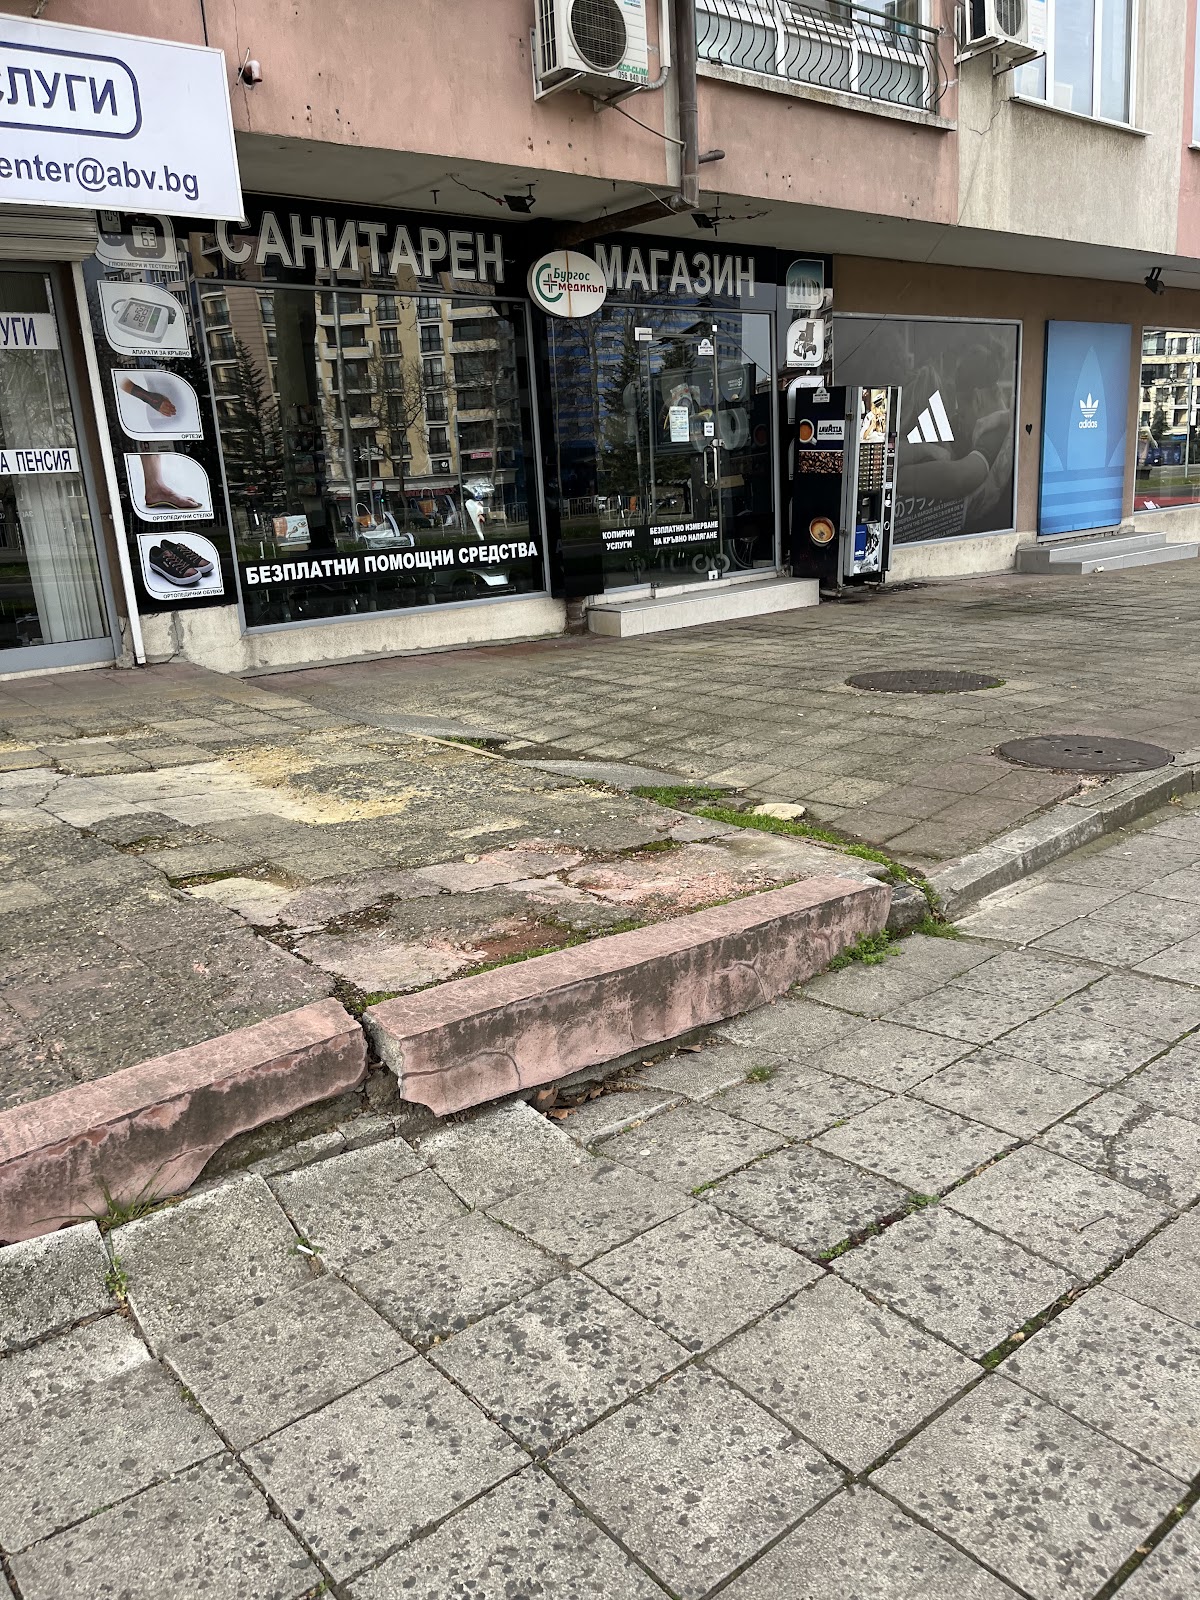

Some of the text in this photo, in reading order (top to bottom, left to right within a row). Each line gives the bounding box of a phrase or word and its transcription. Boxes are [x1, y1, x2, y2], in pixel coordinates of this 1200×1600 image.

[0, 66, 118, 116] ЛУГИ
[0, 155, 199, 200] enter@abv.bg
[215, 211, 505, 283] САНИТАРЕН
[594, 243, 755, 298] МАГАЗИН
[1078, 419, 1098, 428] adidas
[16, 450, 72, 472] ПЕНСИЯ
[602, 529, 635, 540] КОПИРНИ
[650, 521, 718, 535] БЕЗПЛАТНО ИЗМЕРВАНЕ
[663, 536, 687, 544] КРЪВНО
[688, 532, 718, 542] НАЛЯГАНЕ
[606, 541, 632, 550] УСЛУГИ
[246, 541, 538, 585] БЕЗПЛАТНИ ПОМОЩНИ СРЕДСТВА
